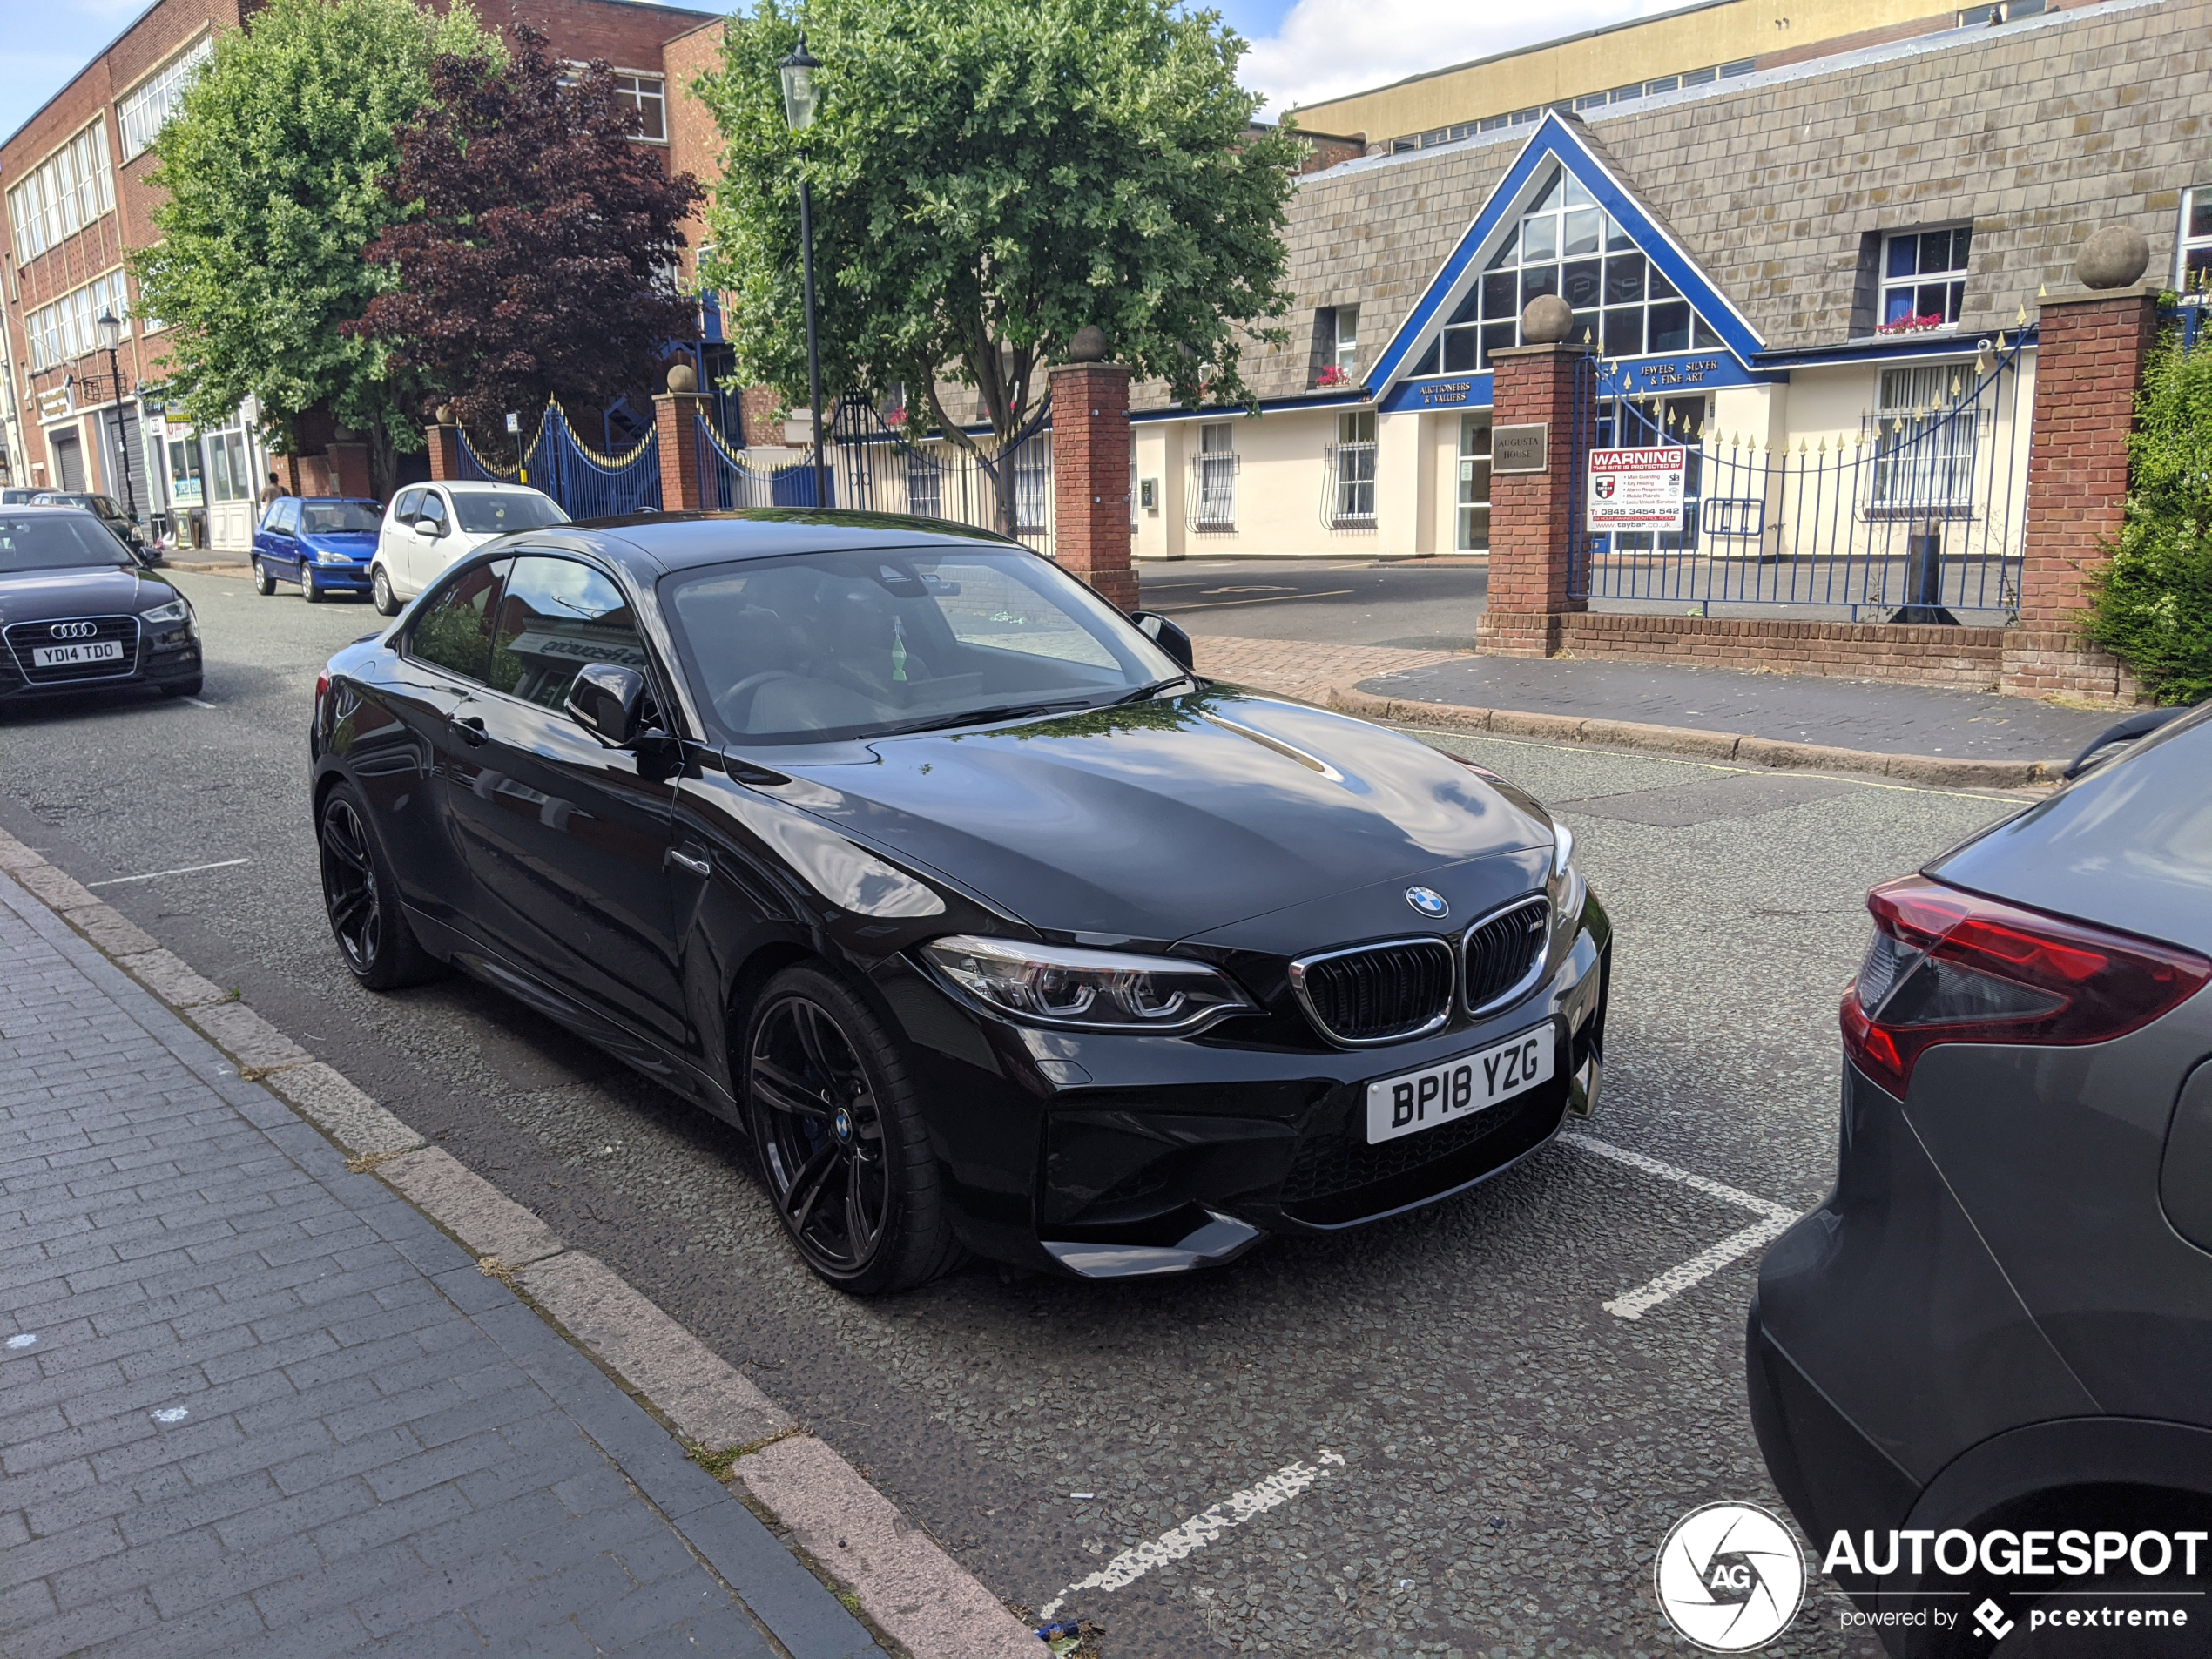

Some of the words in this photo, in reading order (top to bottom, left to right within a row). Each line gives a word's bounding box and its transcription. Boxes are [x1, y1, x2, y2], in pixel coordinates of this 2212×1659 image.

[1640, 364, 1675, 376] JEWELS
[1685, 360, 1717, 372] SILVER
[1650, 376, 1658, 386] &
[1662, 373, 1683, 385] FINE
[1685, 372, 1704, 382] ART
[1420, 382, 1471, 395] AUCTIONEERS
[1424, 395, 1431, 404] &
[1434, 393, 1467, 403] VALUERS
[1498, 437, 1539, 448] AUGUSTA
[1503, 450, 1533, 459] HOUSE
[1594, 451, 1681, 465] WARNING
[44, 647, 80, 664] YD14
[83, 644, 114, 659] TDO
[1391, 1064, 1473, 1129] BP18
[1483, 1038, 1539, 1097] YZG
